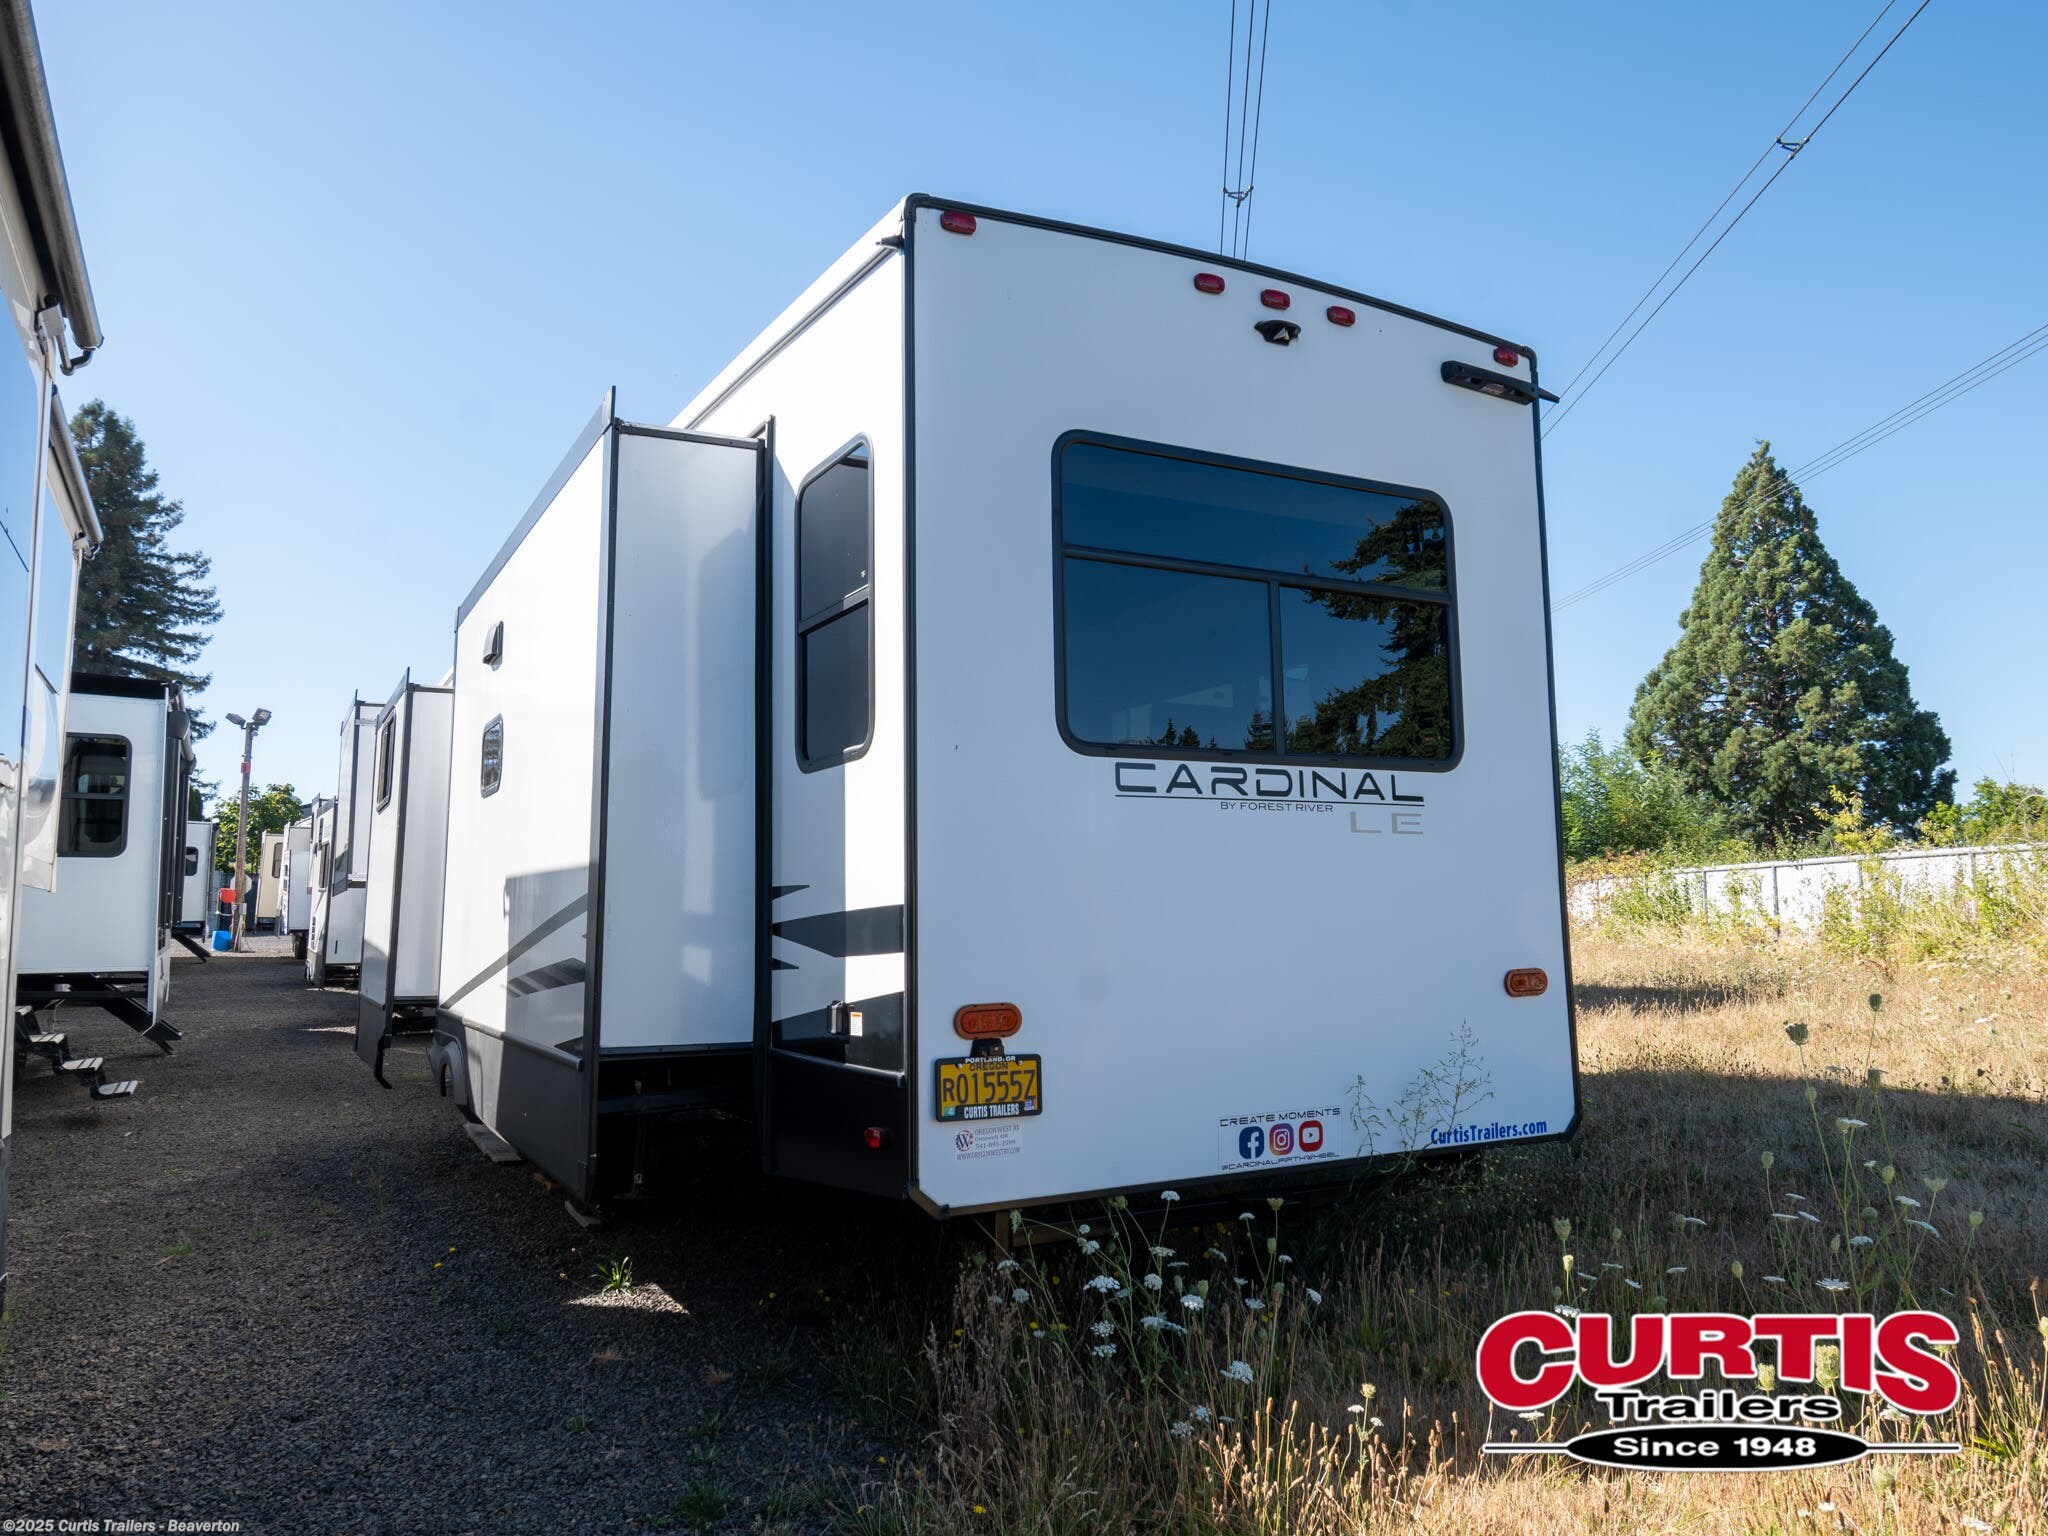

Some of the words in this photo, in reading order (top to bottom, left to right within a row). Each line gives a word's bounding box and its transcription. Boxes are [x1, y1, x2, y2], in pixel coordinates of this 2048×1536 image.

[1115, 761, 1424, 802] CARDINAL
[1220, 801, 1236, 810] BY
[1240, 802, 1292, 812] FOREST
[1295, 803, 1334, 813] RIVER
[1350, 811, 1424, 835] LE
[969, 1062, 1008, 1071] OREGON
[942, 1069, 1036, 1105] R01555Z
[963, 1105, 988, 1119] CURTIS
[989, 1103, 1019, 1117] TRAILERS
[1220, 1114, 1275, 1127] CREATE
[1279, 1107, 1341, 1121] MOMENTS
[1430, 1121, 1548, 1145] CurtisTrailers.com
